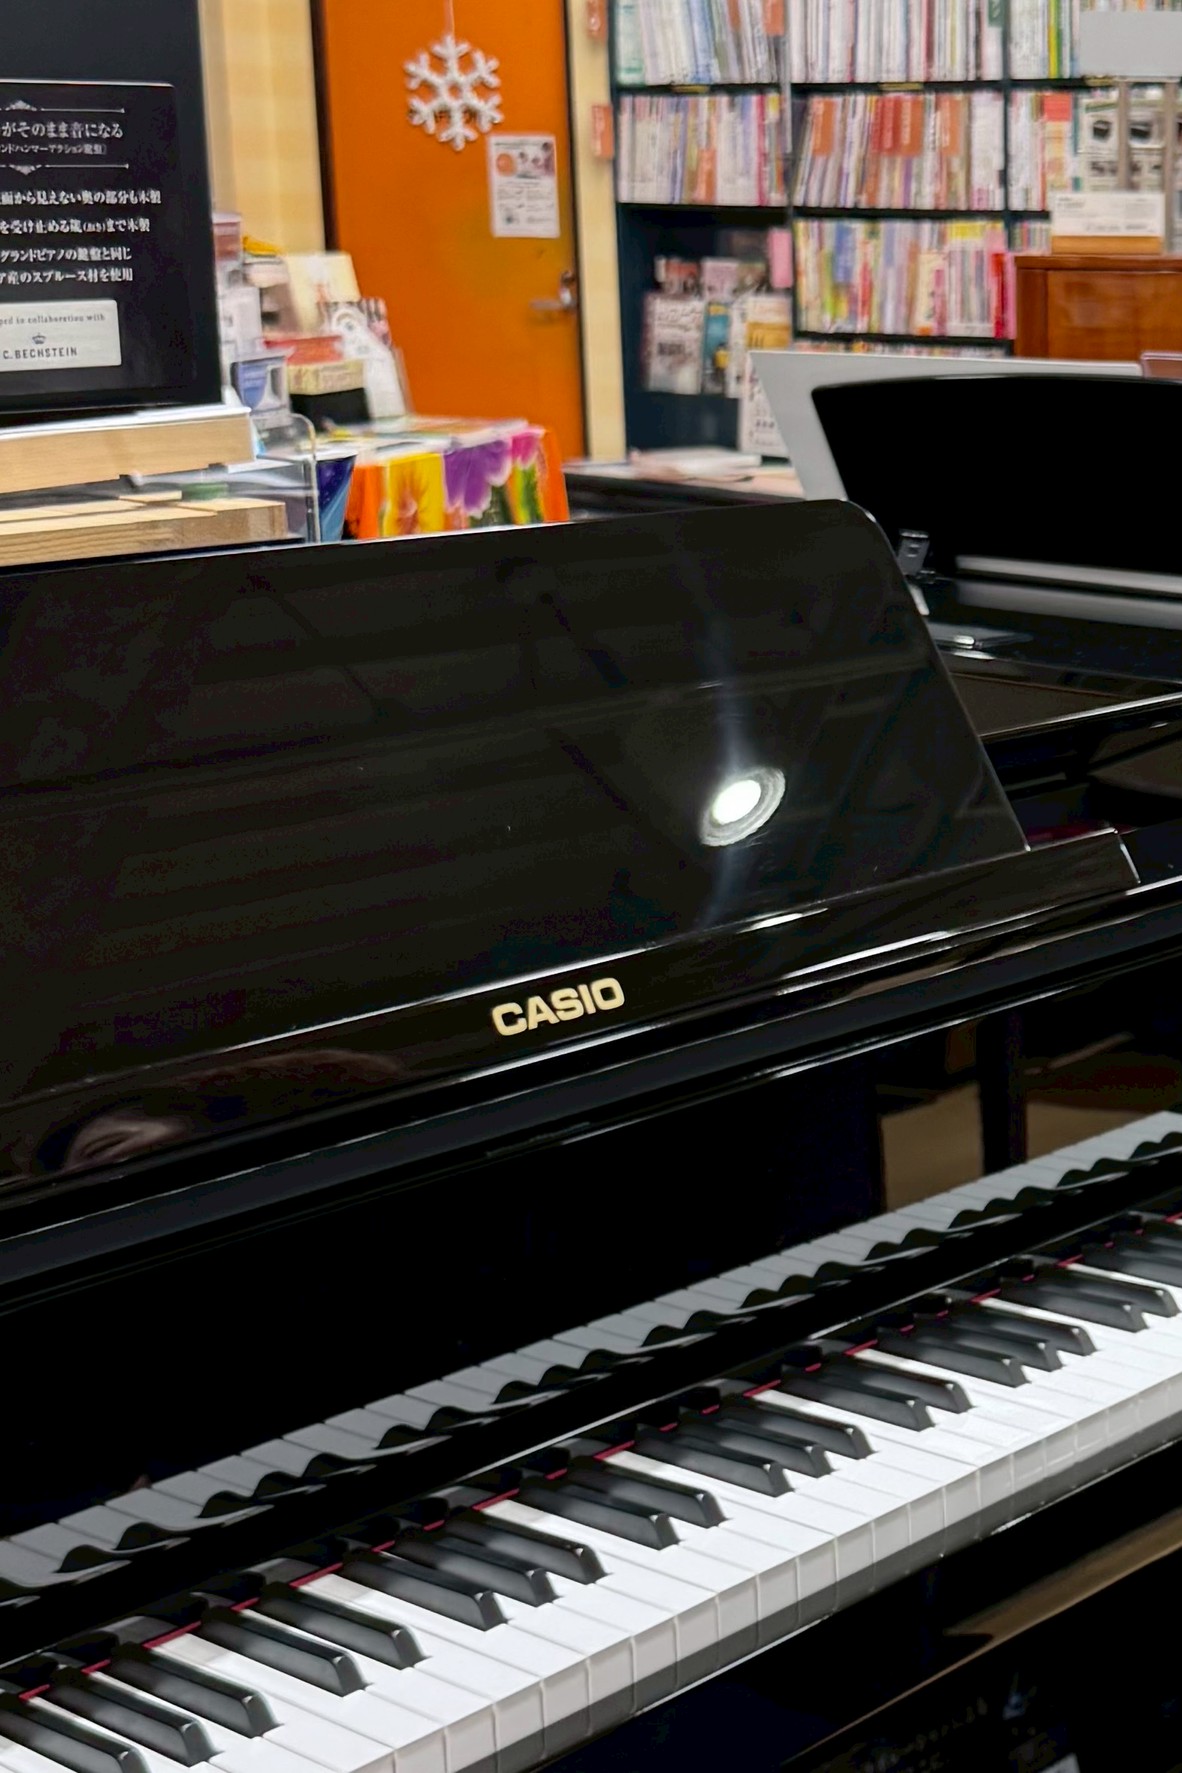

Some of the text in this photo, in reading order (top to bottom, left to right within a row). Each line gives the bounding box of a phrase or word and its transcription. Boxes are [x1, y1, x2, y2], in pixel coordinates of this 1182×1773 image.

[0, 189, 161, 205] 面から見えない奥の部分も木製
[86, 313, 105, 321] with
[491, 977, 625, 1036] CASIO
